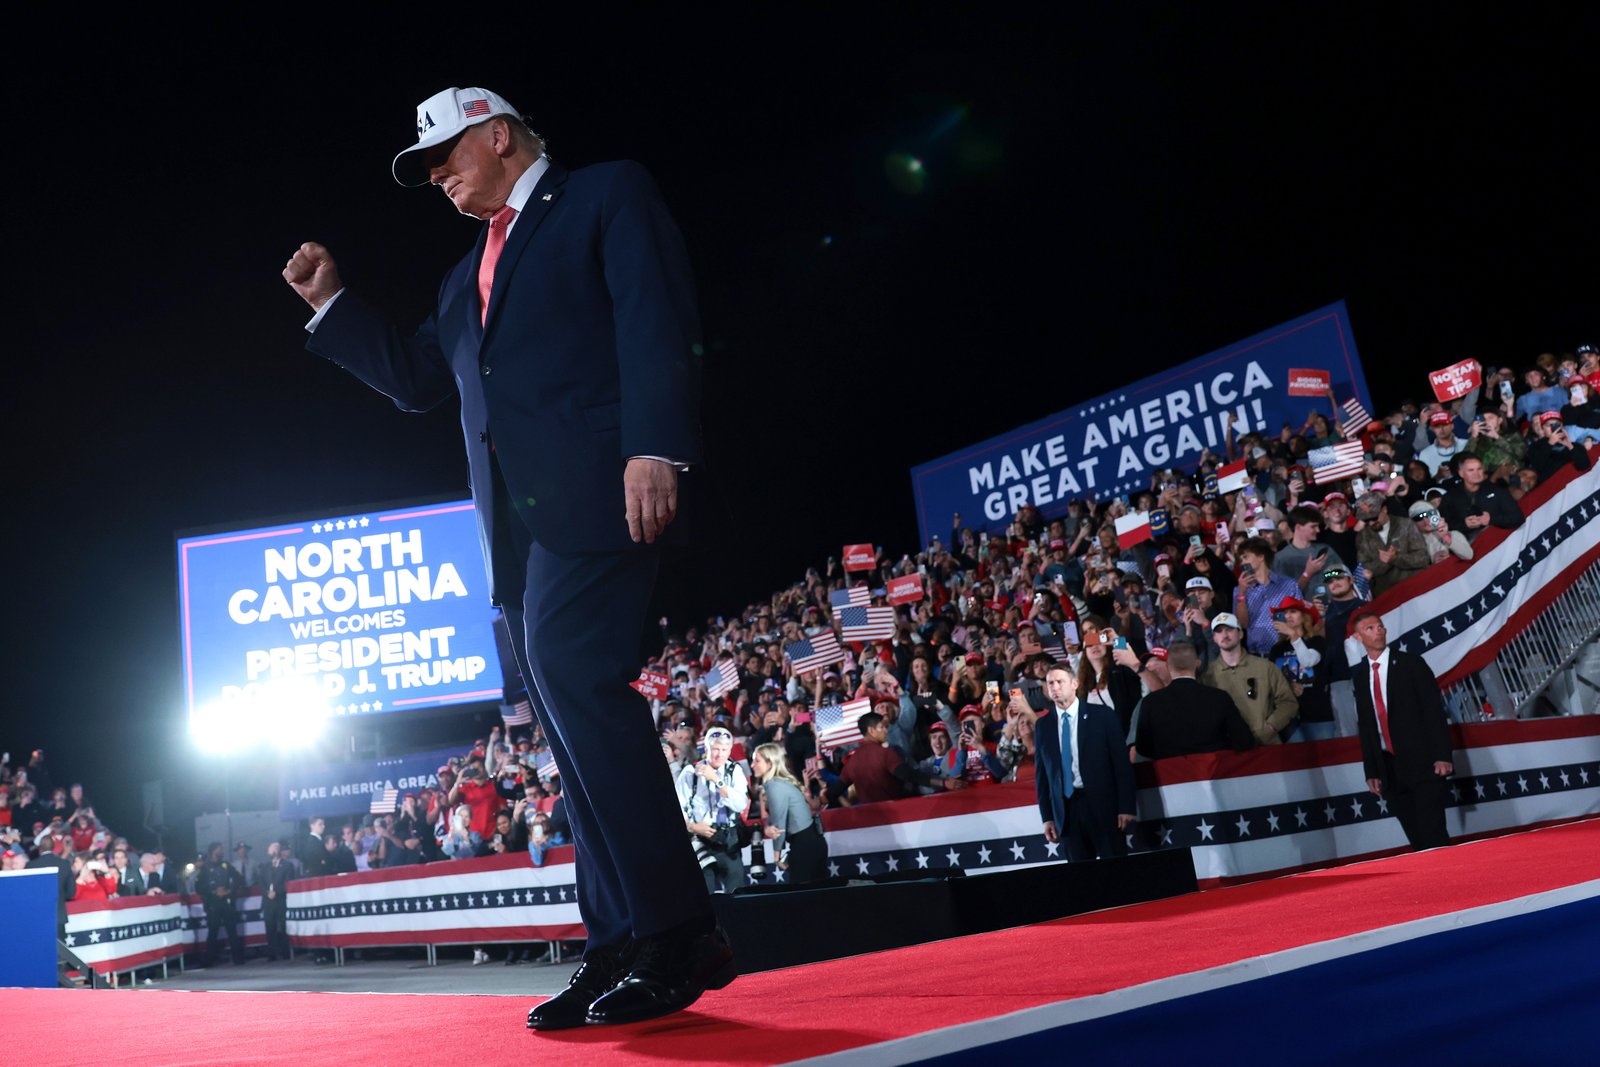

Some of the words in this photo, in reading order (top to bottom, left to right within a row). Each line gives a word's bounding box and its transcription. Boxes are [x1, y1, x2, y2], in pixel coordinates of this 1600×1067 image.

[1433, 372, 1452, 385] NO
[1452, 361, 1475, 376] TAX
[1447, 379, 1472, 395] TIPS
[969, 435, 1068, 494] MAKE
[1083, 361, 1273, 455] AMERICA
[984, 457, 1099, 521] GREAT
[1117, 399, 1266, 478] AGAIN!
[265, 529, 423, 583] NORTH
[229, 562, 468, 625] CAROLINA
[290, 609, 406, 639] WELCOMES
[246, 626, 455, 681] PRESIDENT
[352, 669, 376, 694] J.
[381, 656, 486, 690] TRUMP
[637, 683, 658, 695] TIPS
[649, 674, 668, 686] TAX
[289, 786, 326, 801] MAKE
[331, 780, 393, 797] AMERICA
[398, 774, 438, 789] GREA
